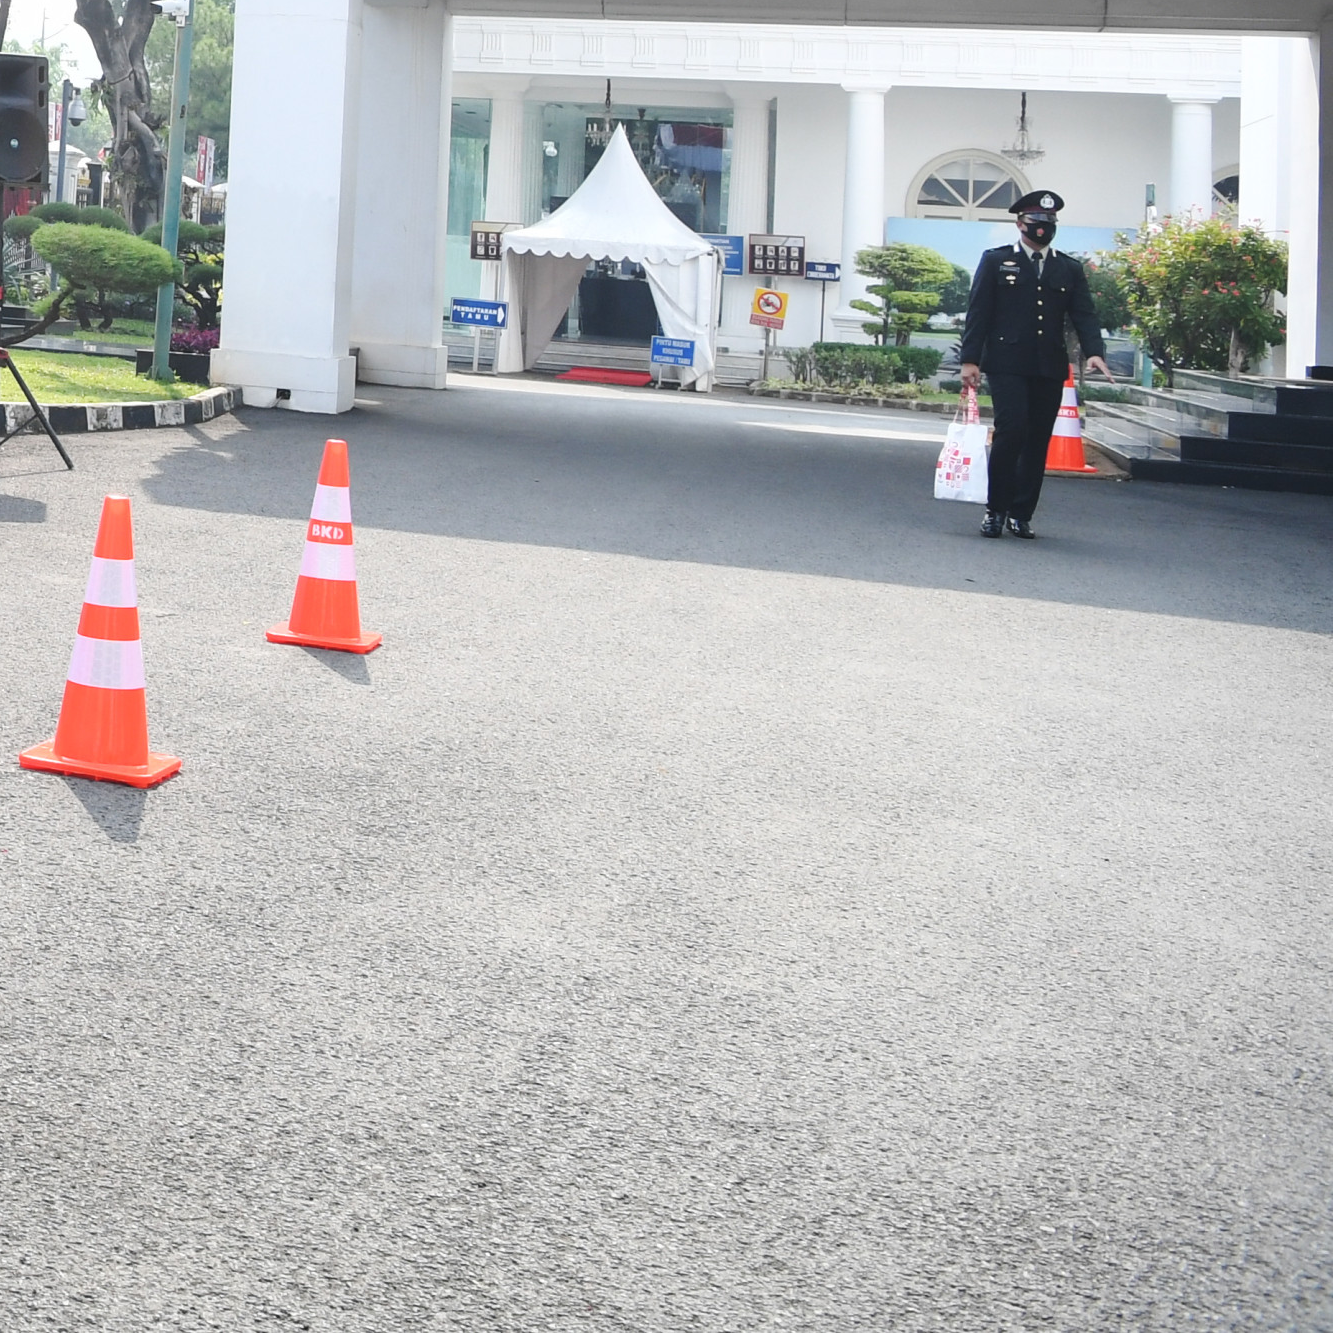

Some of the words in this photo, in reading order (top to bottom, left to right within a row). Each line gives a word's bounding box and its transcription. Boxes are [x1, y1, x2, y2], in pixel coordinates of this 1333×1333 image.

[453, 305, 498, 315] PENDAFTARAN
[460, 312, 489, 321] TAMU
[312, 524, 344, 540] BKD
